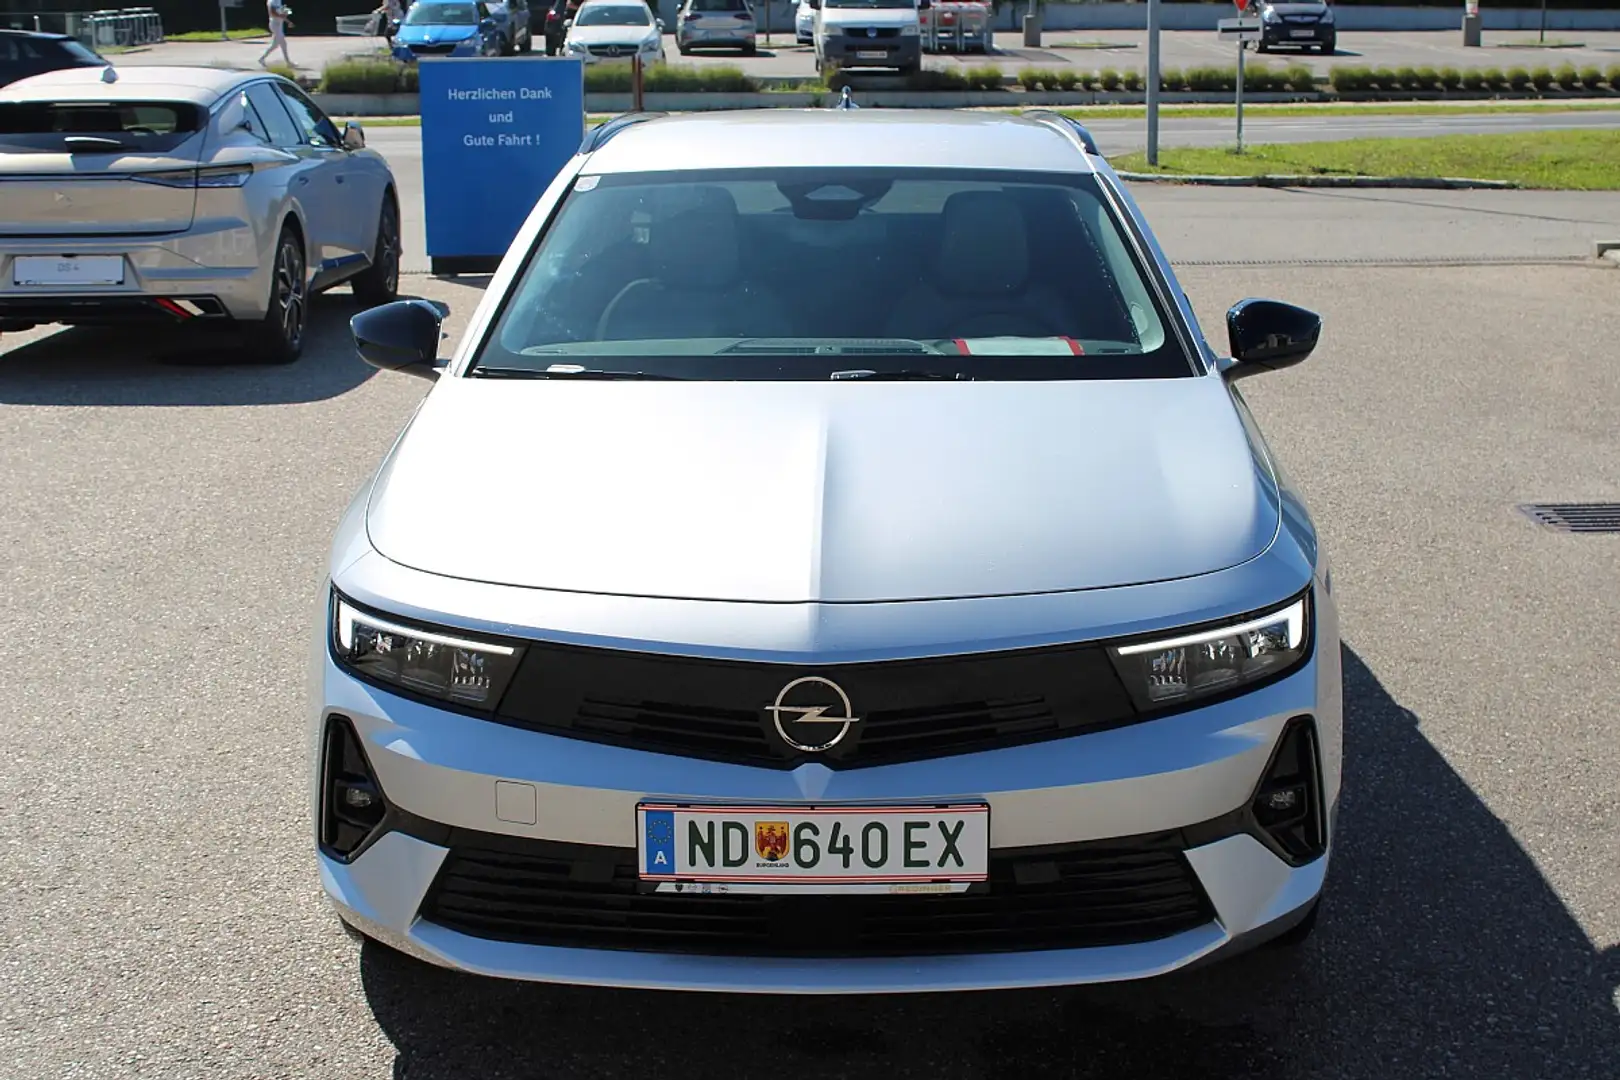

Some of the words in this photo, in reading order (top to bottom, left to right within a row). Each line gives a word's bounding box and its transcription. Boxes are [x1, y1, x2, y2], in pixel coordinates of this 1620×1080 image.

[448, 88, 516, 100] Herzlichen
[520, 87, 552, 99] Dank
[489, 111, 513, 123] und
[463, 135, 494, 146] Gute
[498, 134, 532, 146] Fahrt
[536, 134, 541, 145] !
[688, 820, 749, 868] ND
[654, 851, 668, 865] A
